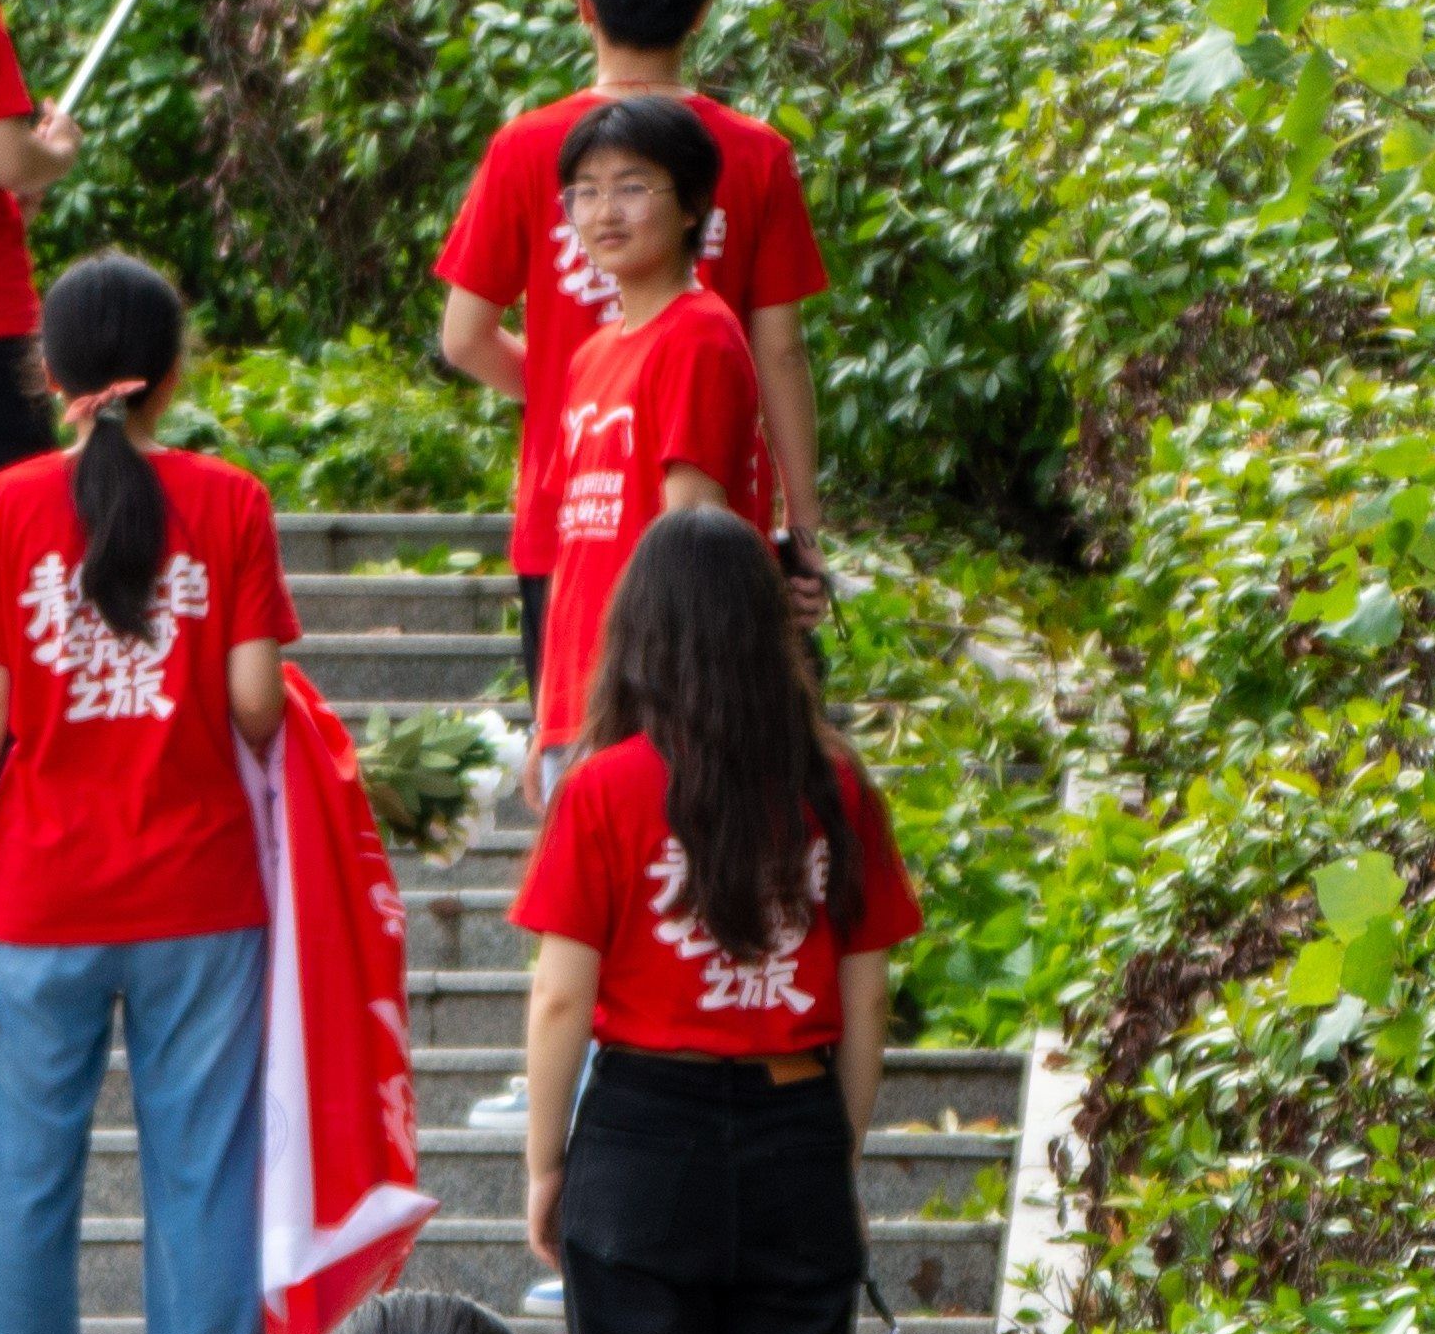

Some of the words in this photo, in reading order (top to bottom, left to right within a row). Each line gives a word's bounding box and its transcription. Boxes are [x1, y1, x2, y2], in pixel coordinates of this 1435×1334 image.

[17, 552, 210, 639] 青色
[65, 667, 177, 722] 之旅
[696, 957, 817, 1015] 之旅
